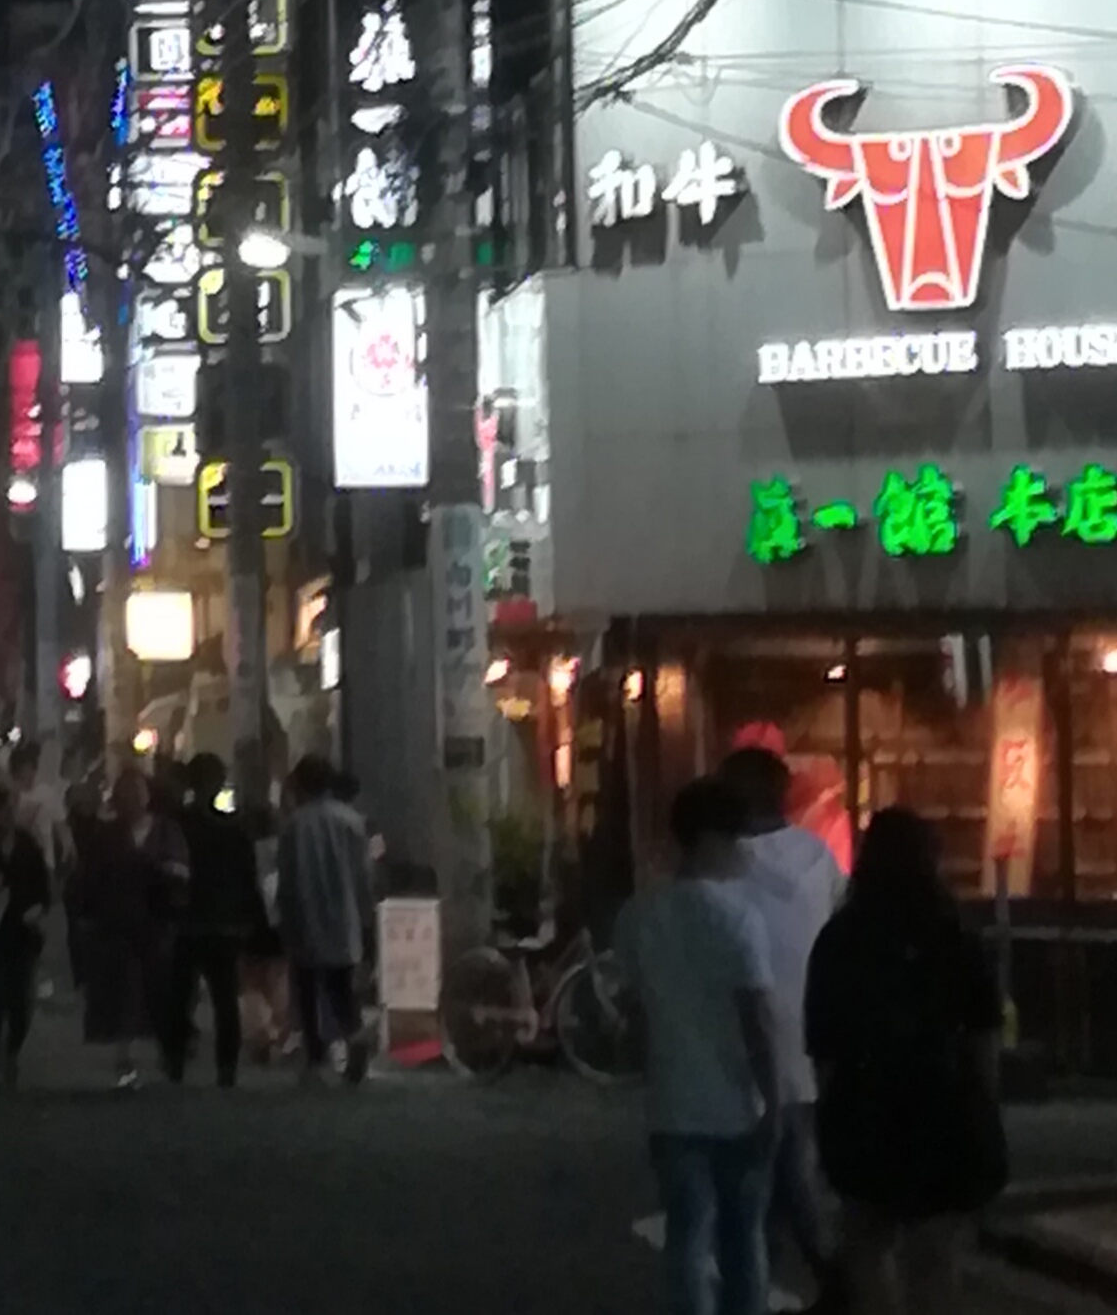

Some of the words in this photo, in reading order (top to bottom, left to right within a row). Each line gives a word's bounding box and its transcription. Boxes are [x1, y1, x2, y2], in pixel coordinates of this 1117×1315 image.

[587, 140, 737, 227] 和牛
[757, 330, 978, 384] BARBECUE
[1003, 323, 1117, 371] HOUS
